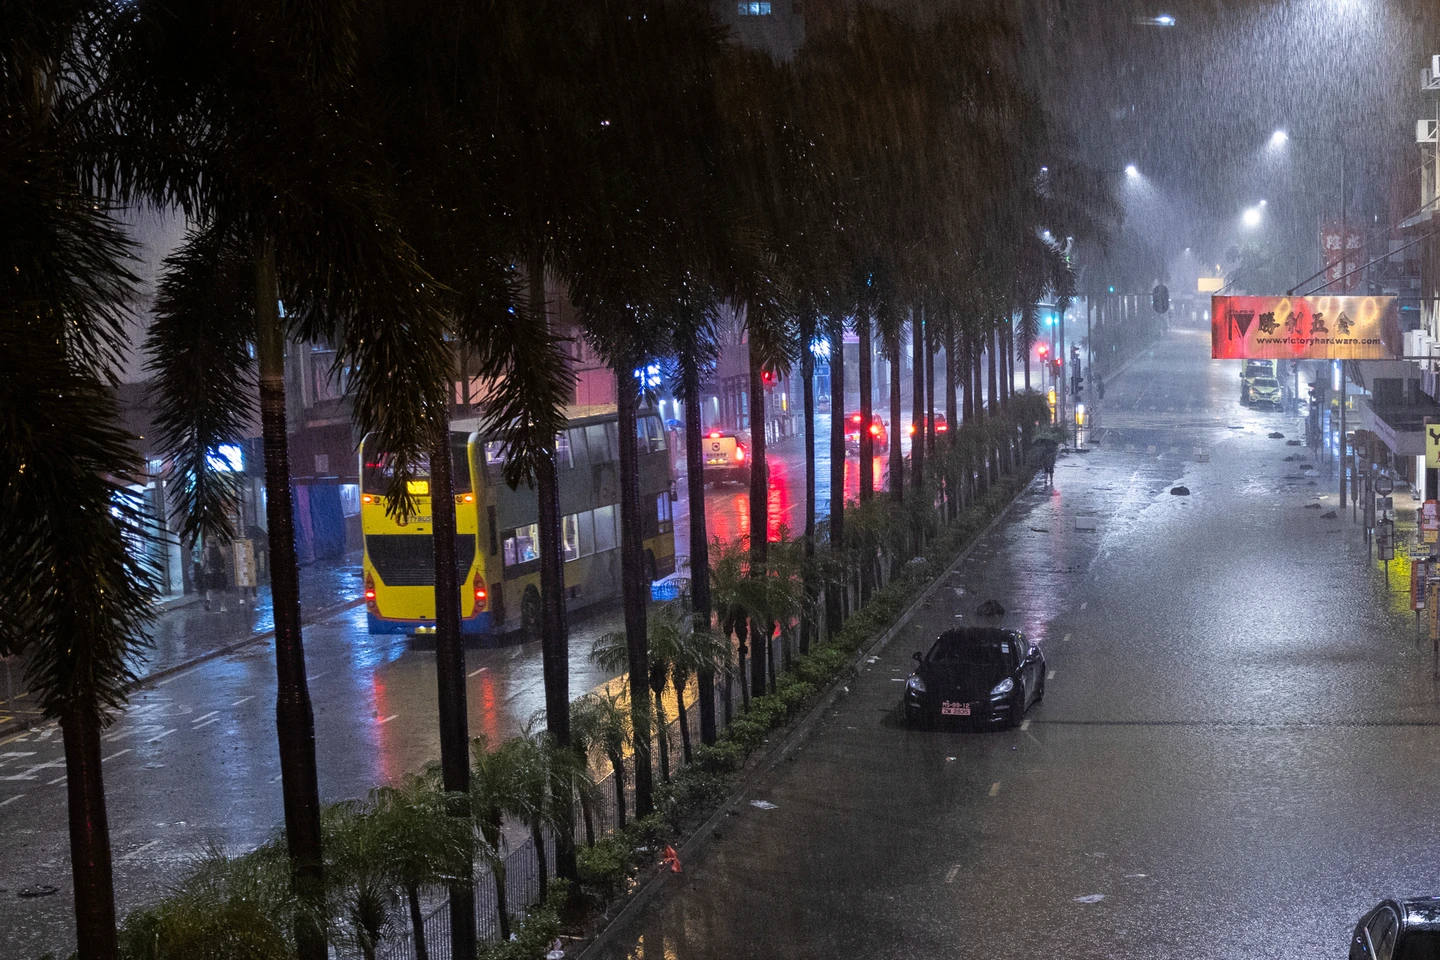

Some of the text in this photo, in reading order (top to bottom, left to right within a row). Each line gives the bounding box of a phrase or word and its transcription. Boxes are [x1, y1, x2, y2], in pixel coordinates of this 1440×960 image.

[1258, 311, 1355, 336] 勝利五金
[1256, 336, 1381, 346] www.victoryhardware.com
